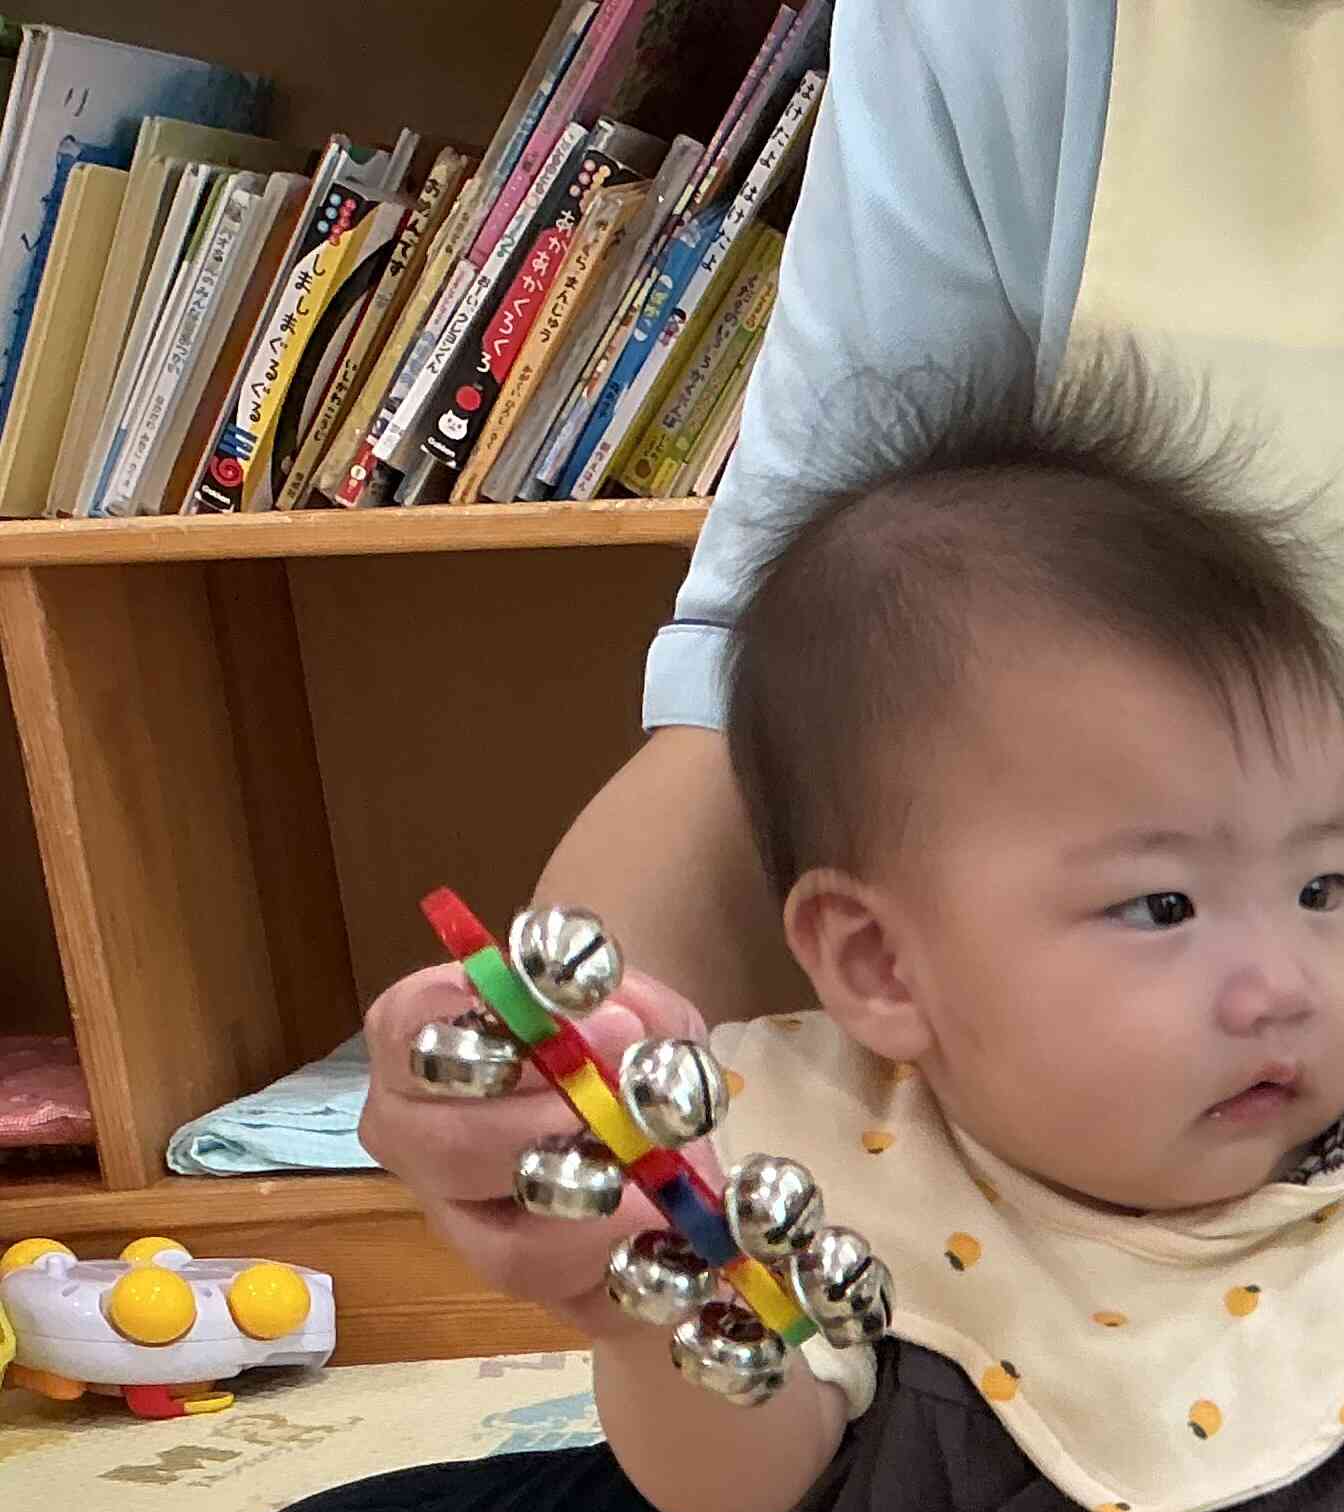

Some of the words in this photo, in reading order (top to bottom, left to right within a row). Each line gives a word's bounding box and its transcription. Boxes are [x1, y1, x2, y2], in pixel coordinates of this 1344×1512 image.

[250, 255, 326, 424] しましまぐるぐる
[476, 210, 576, 373] あかあかくろくろ
